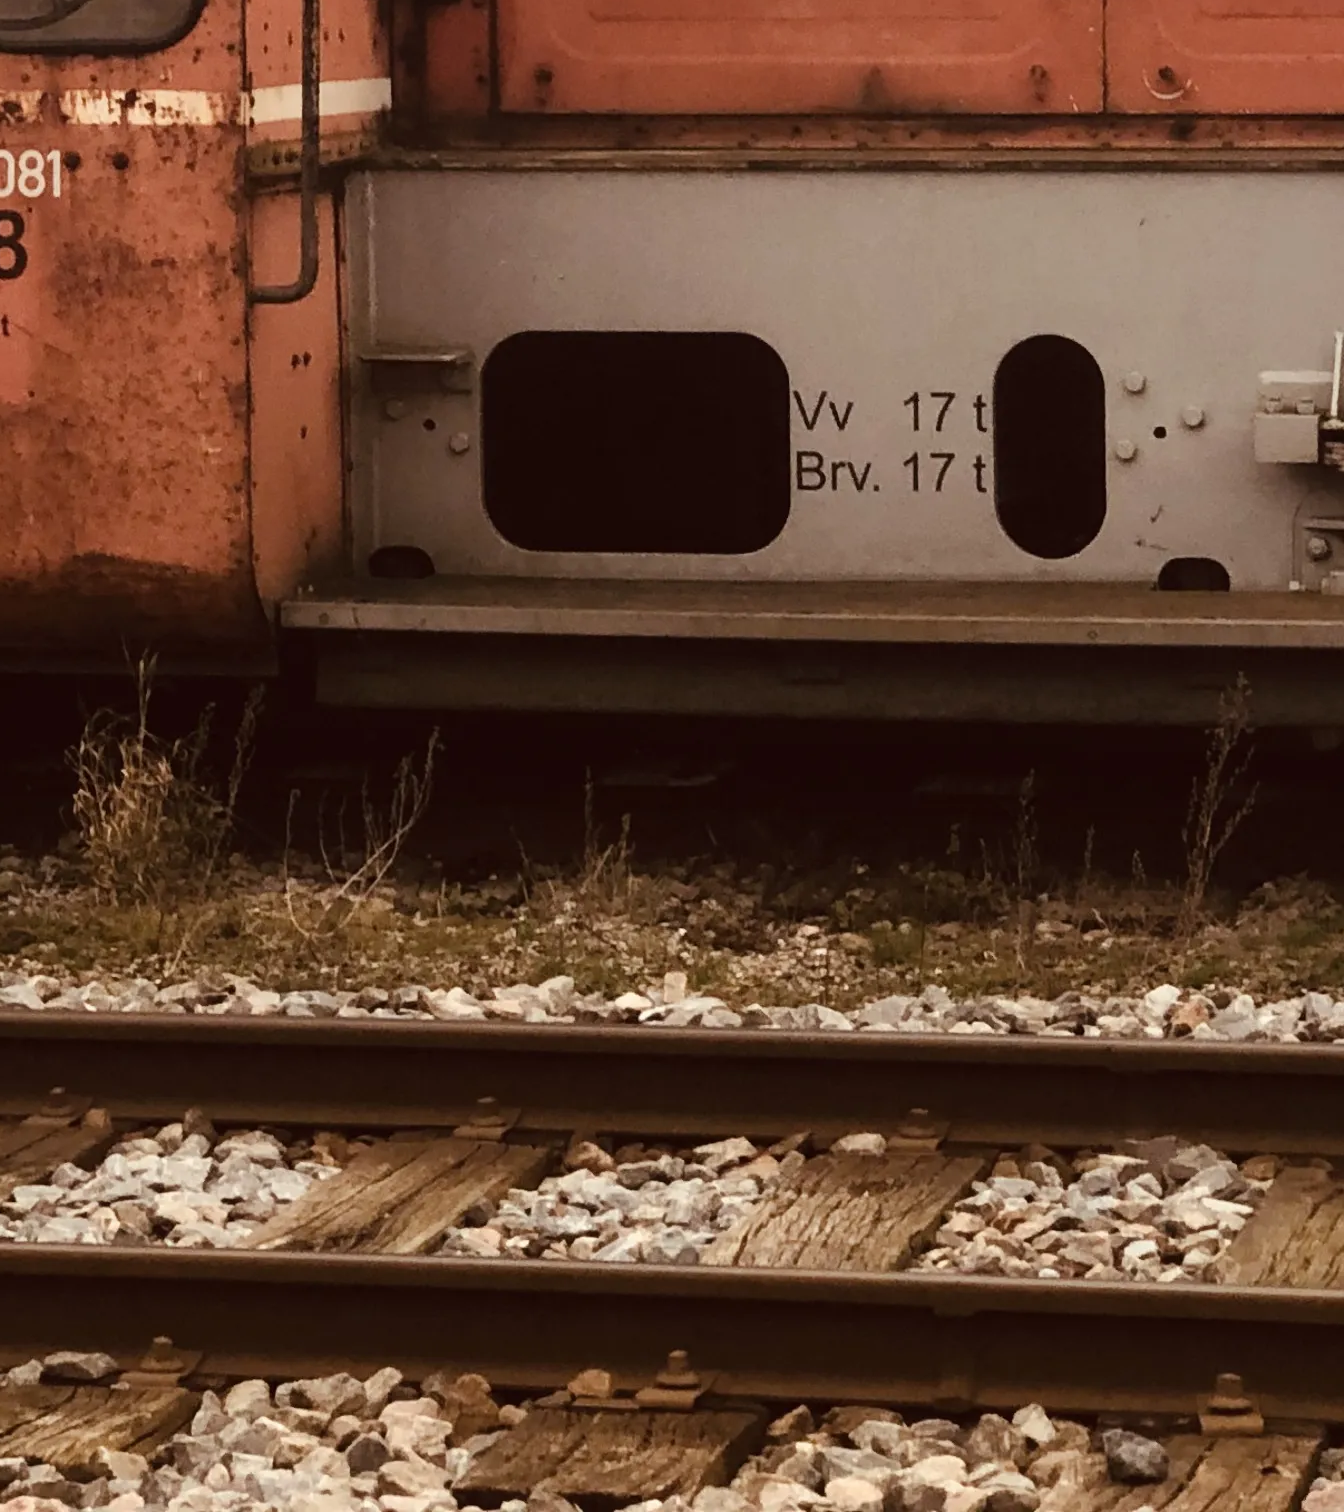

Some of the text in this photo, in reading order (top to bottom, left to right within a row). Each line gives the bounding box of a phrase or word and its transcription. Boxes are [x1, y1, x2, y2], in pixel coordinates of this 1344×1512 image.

[793, 391, 988, 432] Vv 17 t
[796, 451, 988, 493] Brv. 17 t
